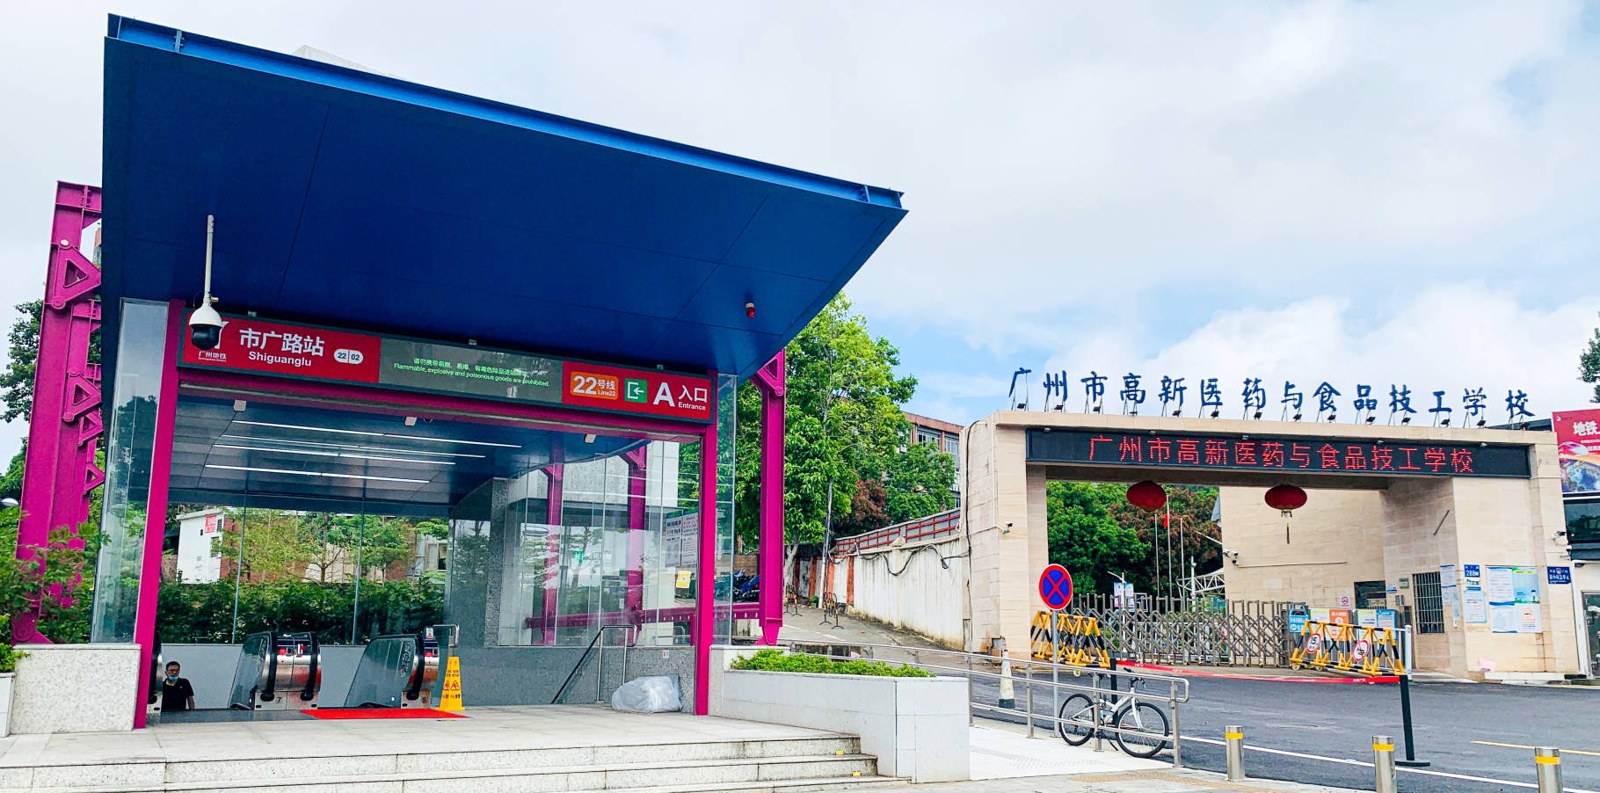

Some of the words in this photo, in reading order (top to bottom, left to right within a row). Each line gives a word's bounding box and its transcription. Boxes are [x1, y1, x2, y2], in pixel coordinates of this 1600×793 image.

[239, 327, 325, 357] 市广路站
[248, 351, 312, 368] Shiguanglu
[337, 351, 347, 361] 22
[350, 352, 361, 362] 02
[427, 367, 454, 377] explosive
[466, 371, 494, 381] poisonous
[494, 376, 513, 384] goods
[652, 382, 676, 407] A
[678, 385, 708, 403] 入口
[1008, 367, 1536, 418] 广州市高新医药与食品技工学校
[678, 402, 706, 411] Entrance
[1572, 420, 1600, 437] 地铁
[1088, 435, 1475, 474] 广州市高新医药与食品技工学校
